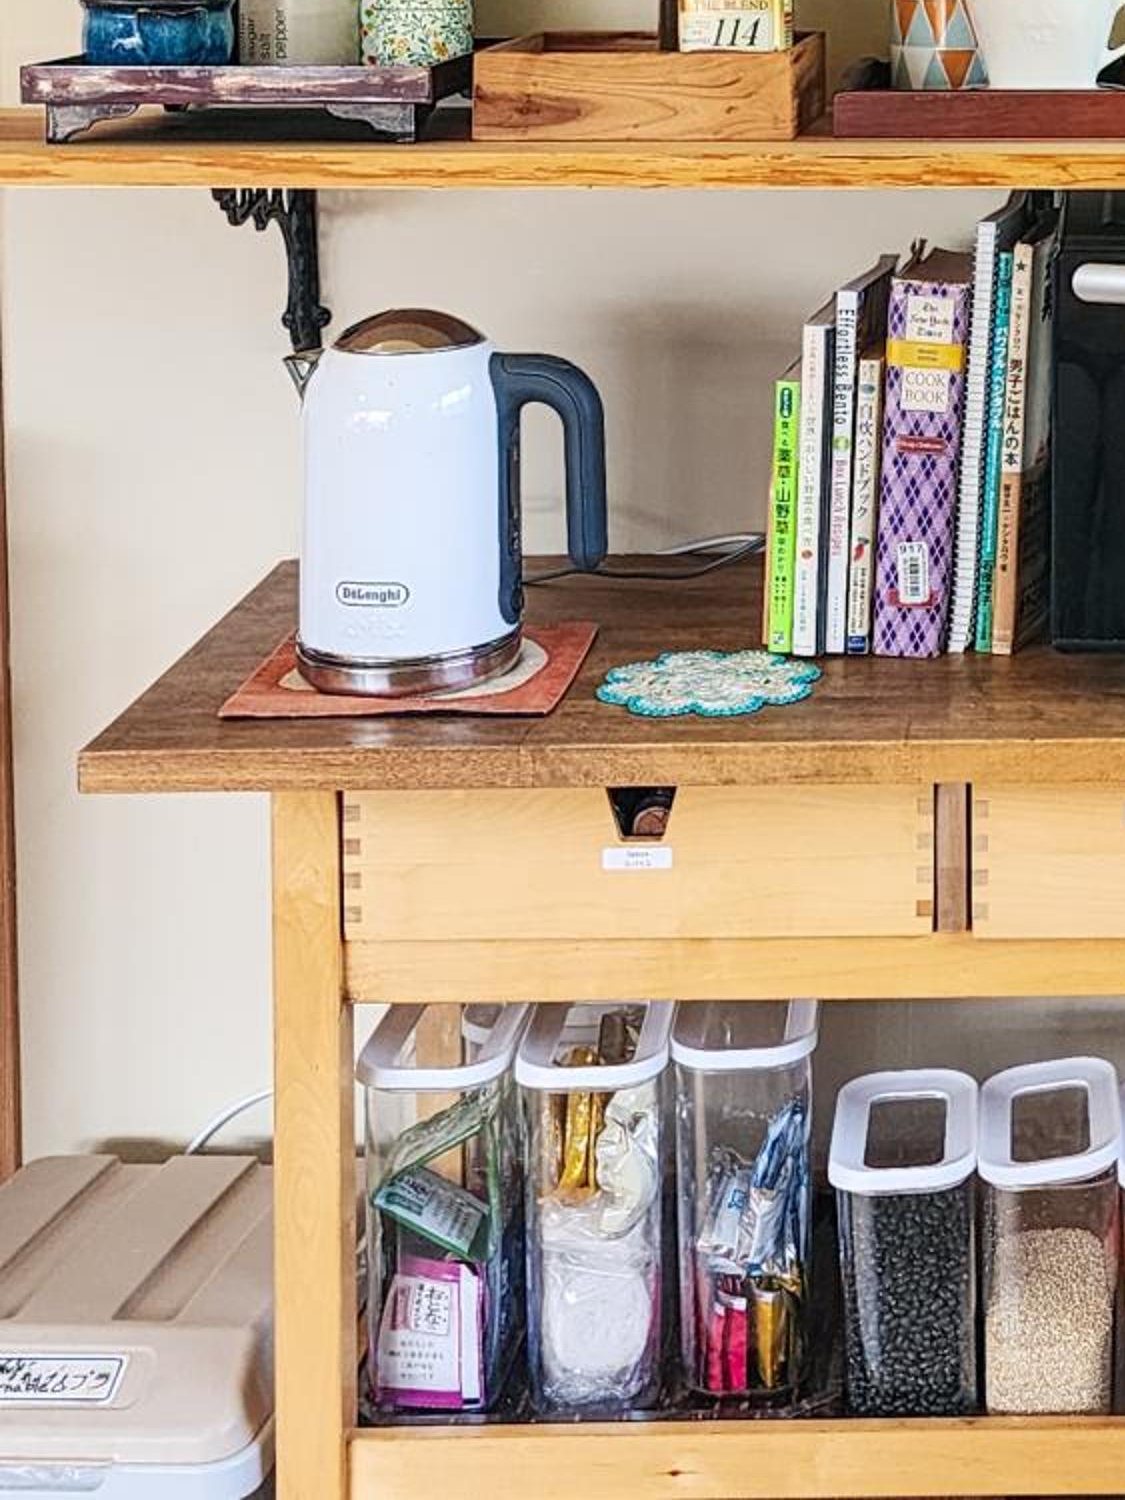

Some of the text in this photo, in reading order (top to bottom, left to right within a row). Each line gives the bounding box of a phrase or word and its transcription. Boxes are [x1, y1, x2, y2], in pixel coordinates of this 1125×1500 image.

[275, 6, 288, 60] pepper
[712, 17, 761, 47] 114
[259, 33, 271, 60] salt
[834, 308, 855, 425] Effortless Bento
[905, 371, 946, 387] COOK
[905, 389, 945, 405] BOOK
[1004, 358, 1023, 466] 男子ごはんの本
[342, 586, 401, 603] DeLonghi
